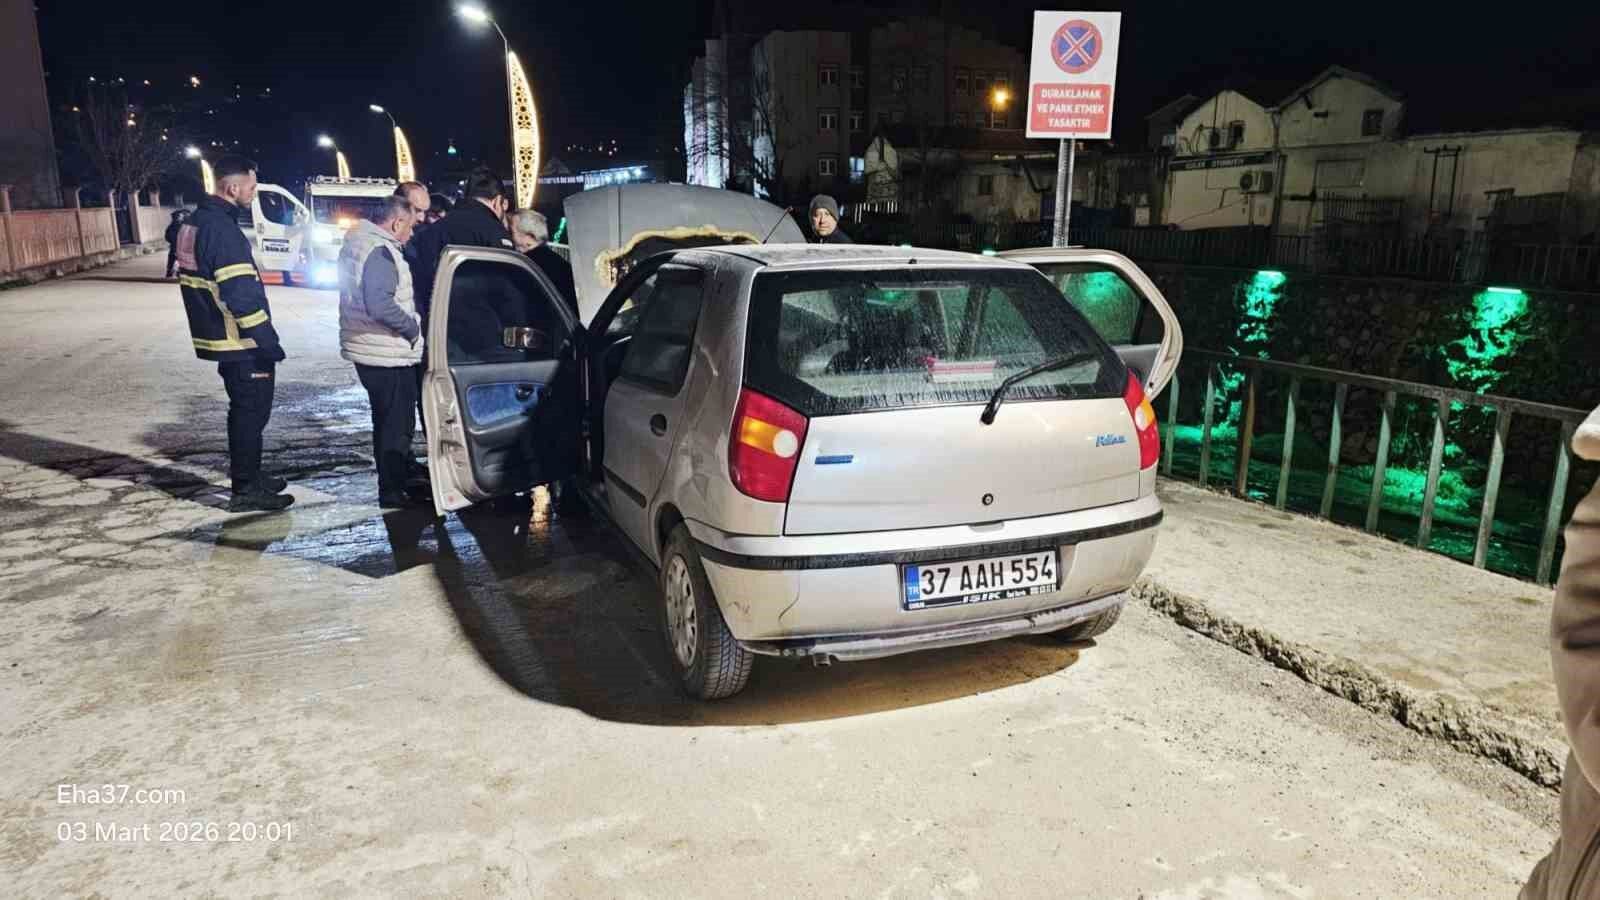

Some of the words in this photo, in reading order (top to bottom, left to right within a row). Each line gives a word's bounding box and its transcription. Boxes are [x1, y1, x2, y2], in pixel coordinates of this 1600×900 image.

[1041, 88, 1101, 98] DURAKLAMAK
[1037, 103, 1048, 113] VE
[1049, 103, 1072, 113] PARK
[1073, 103, 1105, 114] ETMEK
[1048, 118, 1090, 128] YASAKTIR
[921, 567, 951, 595] 37
[960, 560, 1004, 591] AAH
[1011, 555, 1053, 584] 554
